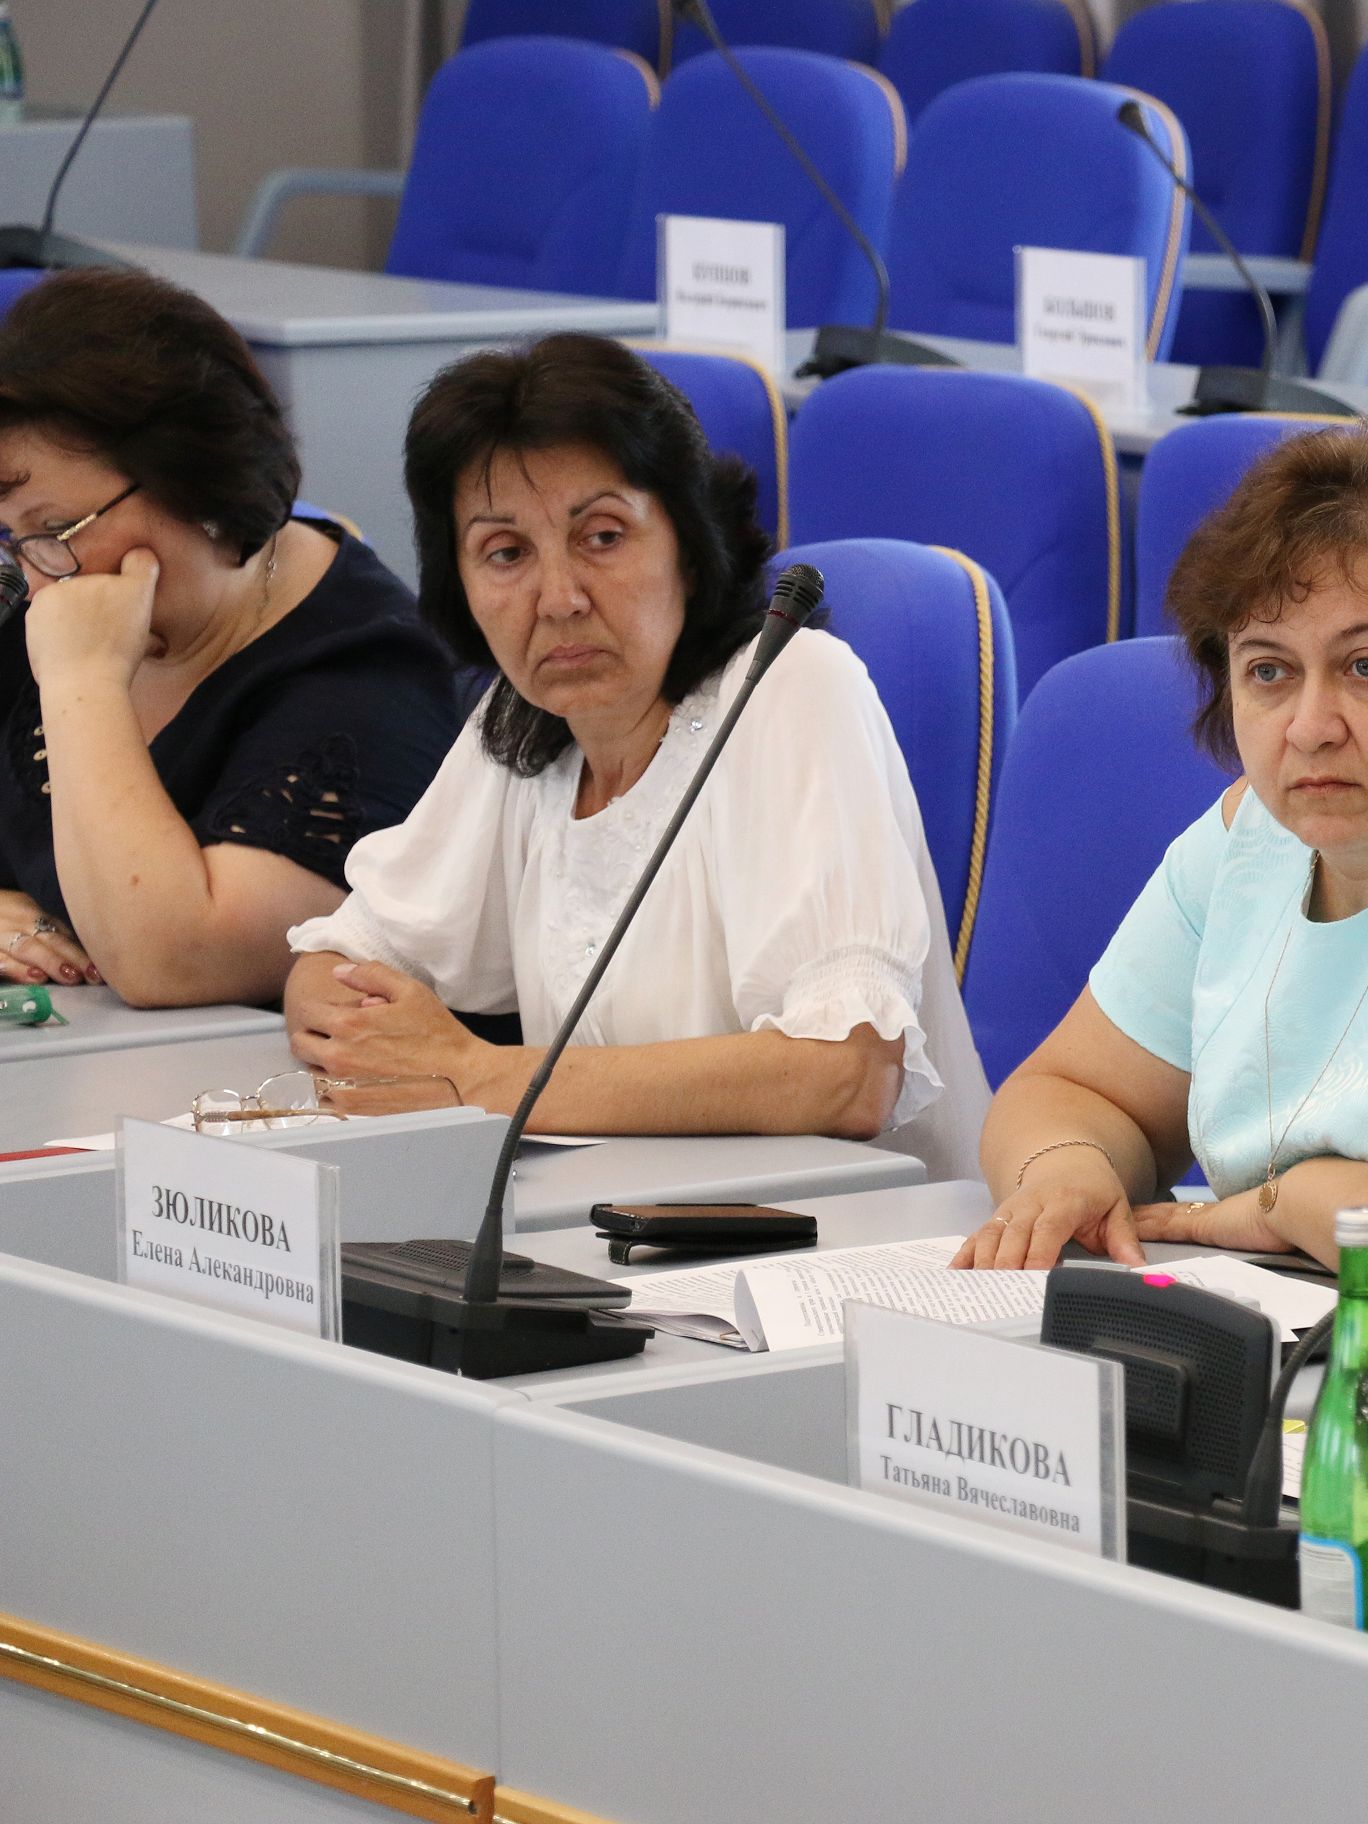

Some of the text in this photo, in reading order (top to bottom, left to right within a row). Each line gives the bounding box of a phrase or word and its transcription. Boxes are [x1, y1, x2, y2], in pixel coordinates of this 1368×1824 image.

[152, 1185, 291, 1252] ЗЮЛИКОВА
[132, 1229, 314, 1304] Елена Алекандровна
[885, 1403, 1072, 1487] ГЛАДИКОВА
[880, 1455, 1080, 1533] Татьяна Вячеславовна
